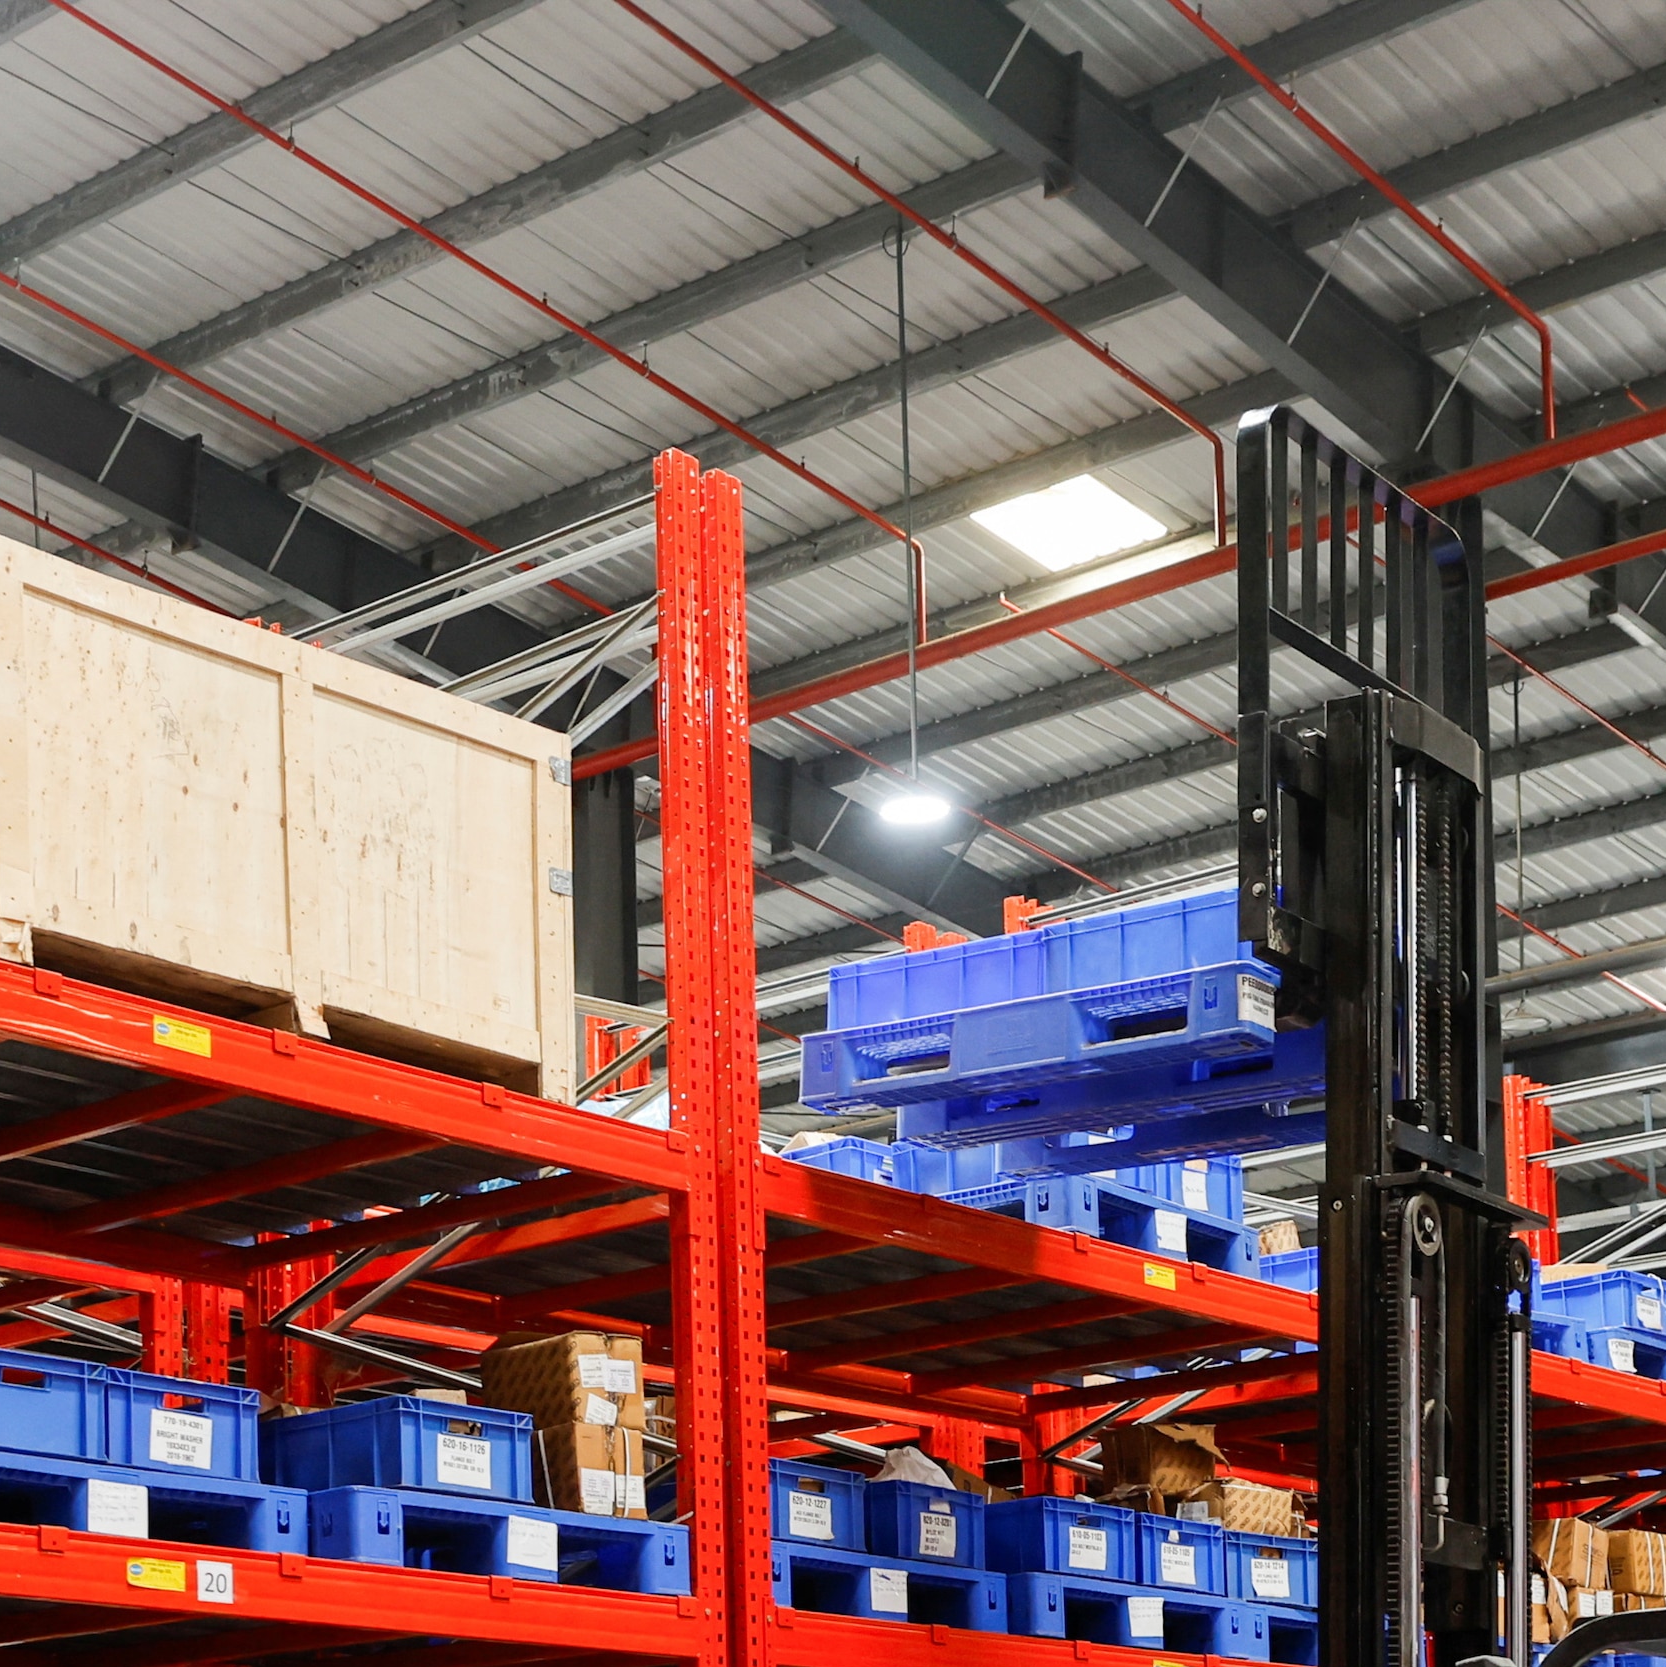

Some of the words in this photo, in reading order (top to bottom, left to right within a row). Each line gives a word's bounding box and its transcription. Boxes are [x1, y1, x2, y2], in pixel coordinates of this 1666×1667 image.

[157, 1429, 178, 1440] BRIGHT
[180, 1433, 203, 1444] WASHER
[442, 1437, 486, 1456] 620-16-1126
[204, 1572, 228, 1593] 20
